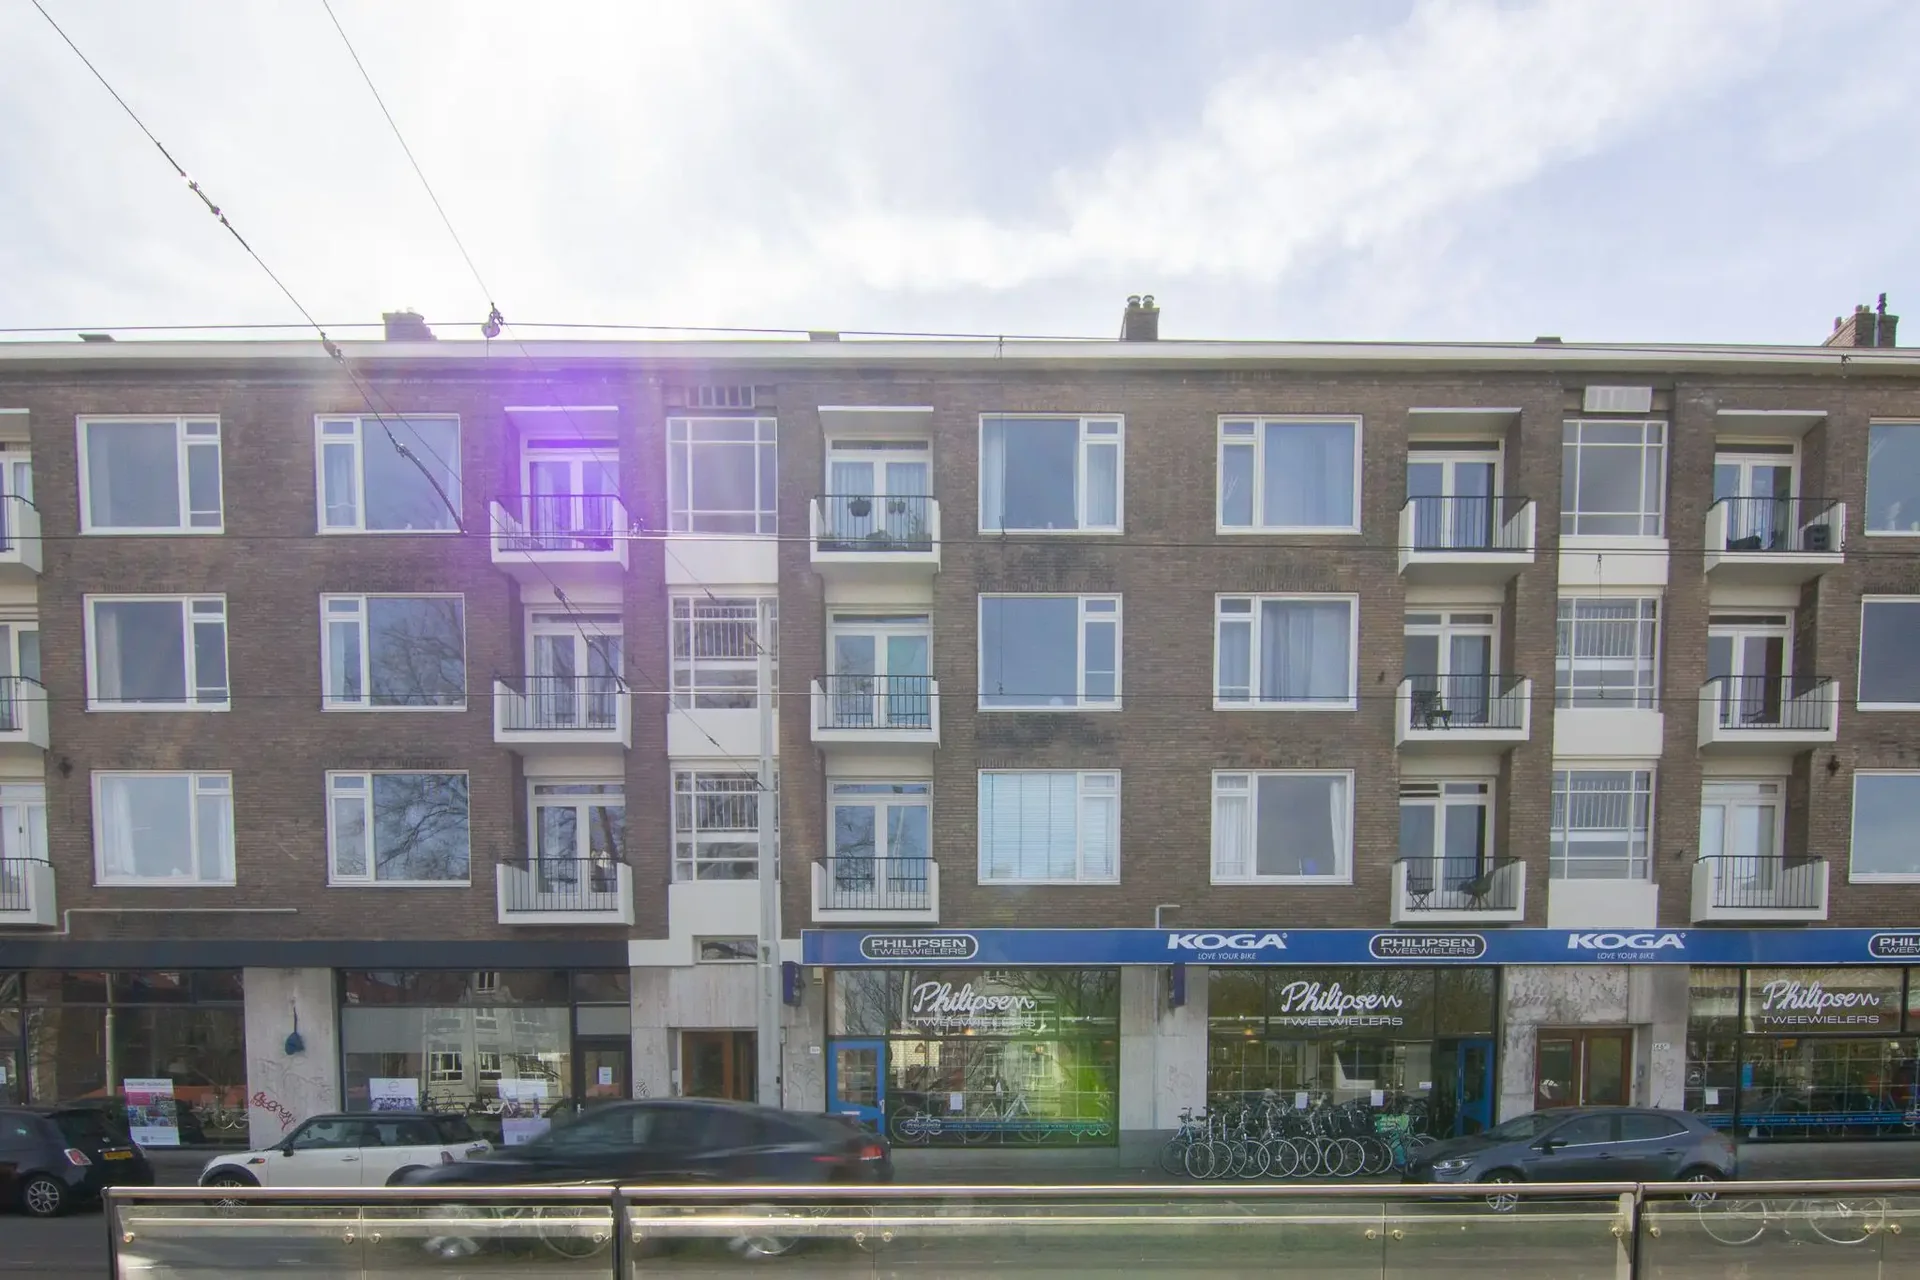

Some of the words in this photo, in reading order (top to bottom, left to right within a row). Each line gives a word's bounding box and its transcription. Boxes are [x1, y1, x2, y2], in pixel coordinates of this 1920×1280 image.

[871, 939, 967, 948] PHILIPSEN
[1167, 933, 1288, 950] KOGA
[1380, 938, 1476, 947] PHILIPSEN
[1567, 933, 1685, 950] KOGA
[1380, 947, 1476, 955] TWEEWIELERS
[1198, 952, 1216, 960] LOVE
[1218, 952, 1239, 960] YOUR
[1240, 952, 1257, 960] BIKE
[1597, 952, 1615, 960] LOVE
[1617, 952, 1637, 960] YOUR
[1639, 952, 1655, 960] BIKE
[912, 981, 1035, 1018] Philipsen
[1280, 981, 1403, 1017] Philipsen
[1762, 980, 1880, 1015] Philipsen
[1283, 1017, 1403, 1026] TWEEWIELERS
[1761, 1015, 1880, 1024] TWEEWIELERS
